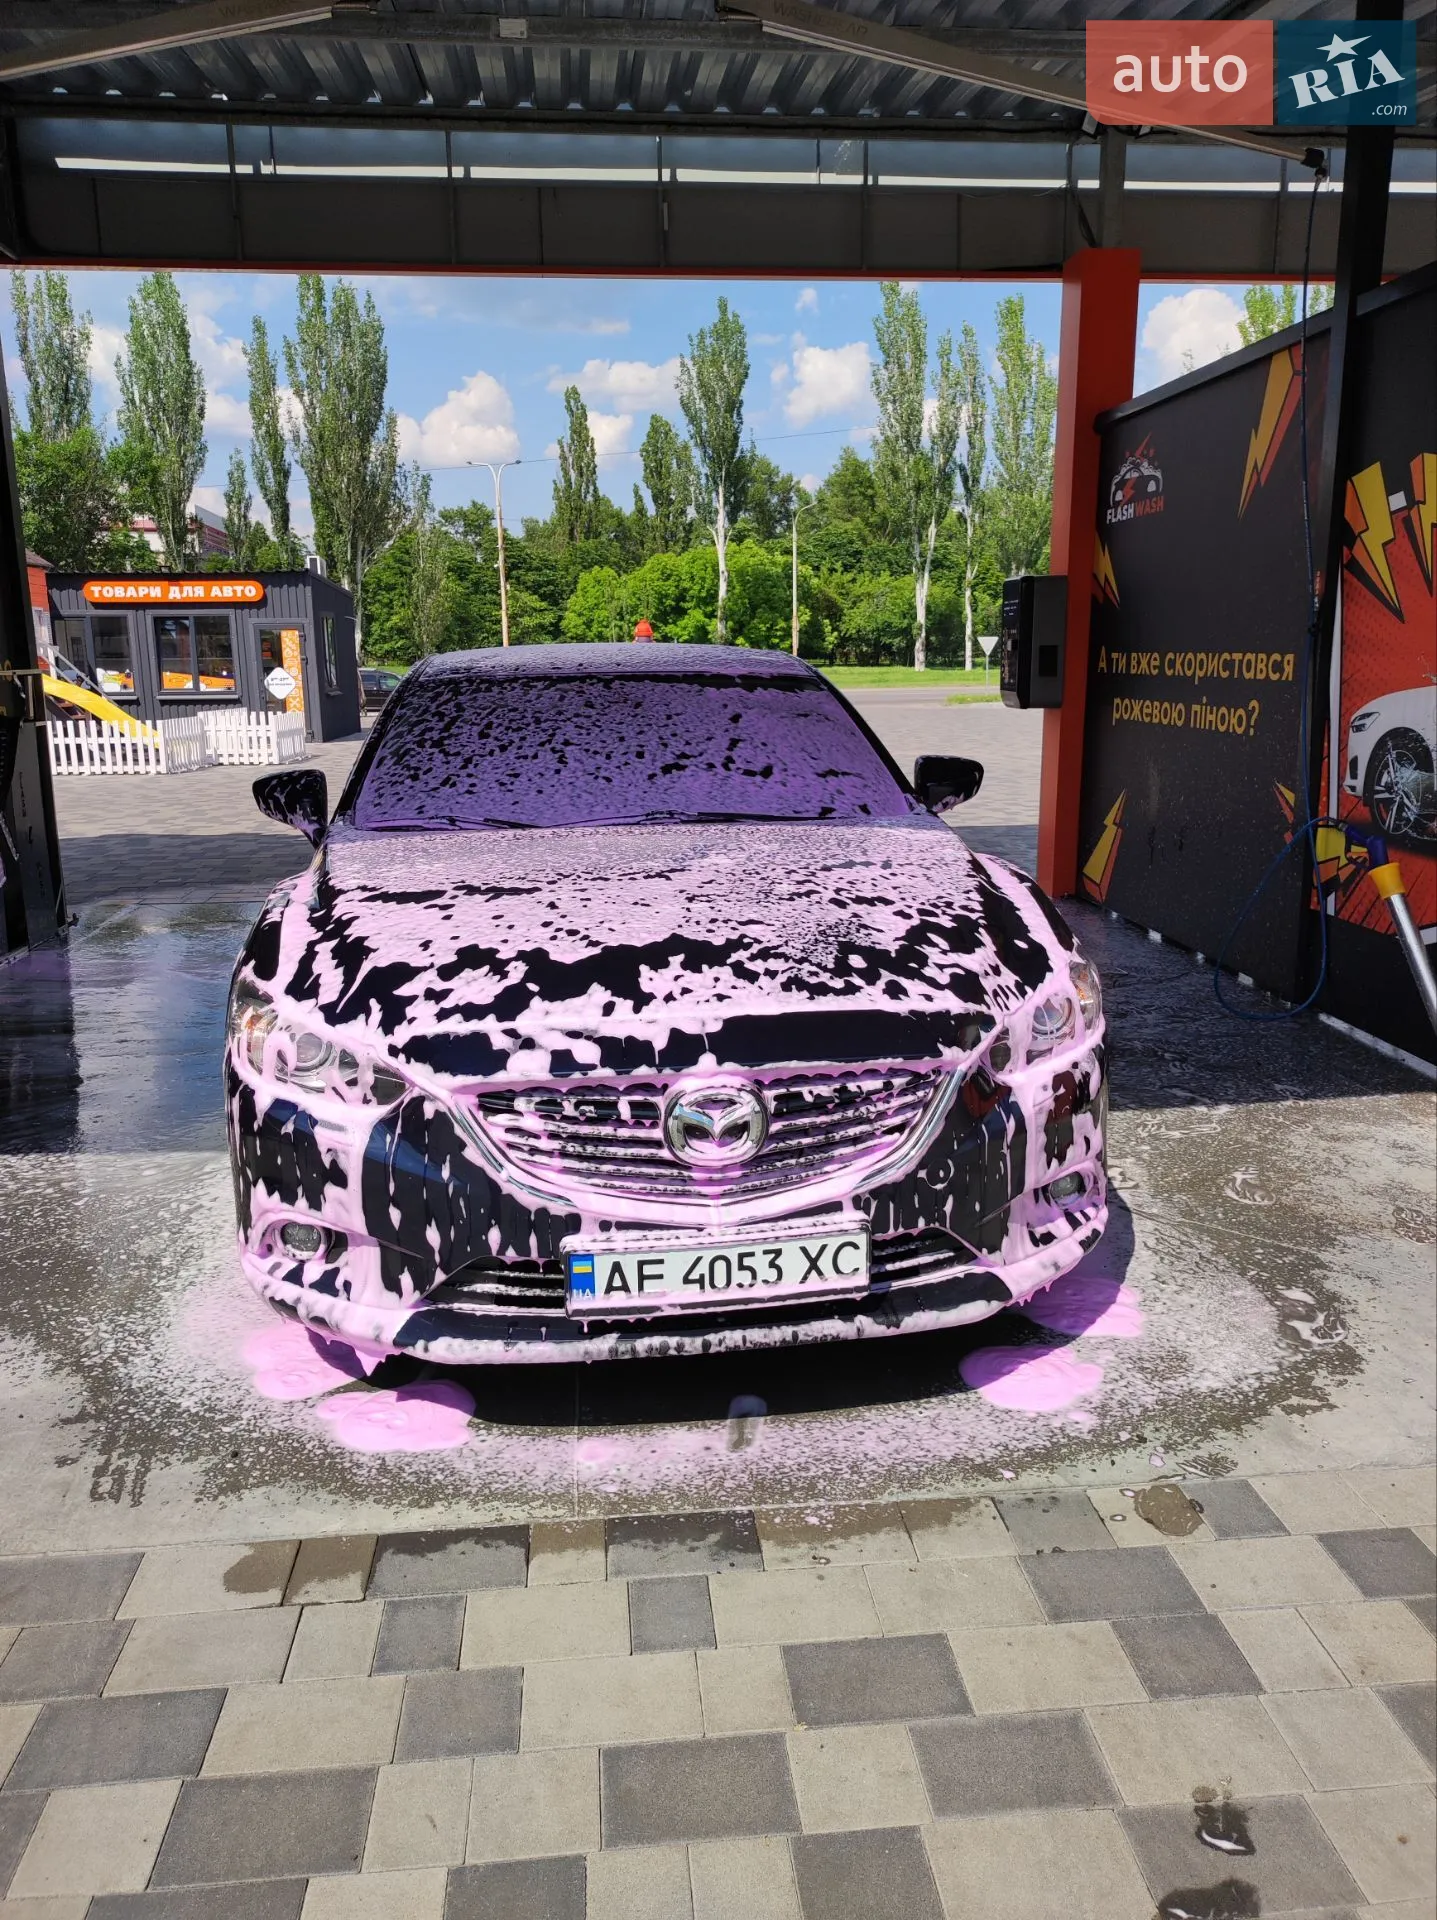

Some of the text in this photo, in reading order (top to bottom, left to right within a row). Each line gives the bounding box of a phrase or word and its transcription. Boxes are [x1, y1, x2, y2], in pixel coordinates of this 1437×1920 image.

[91, 585, 257, 600] ТОВАРИ ДЛЯ АВТО
[1098, 646, 1295, 684] А ти вже скористався
[1112, 696, 1260, 736] рожевою піною?
[682, 1247, 783, 1294] 4053
[799, 1241, 861, 1285] XC
